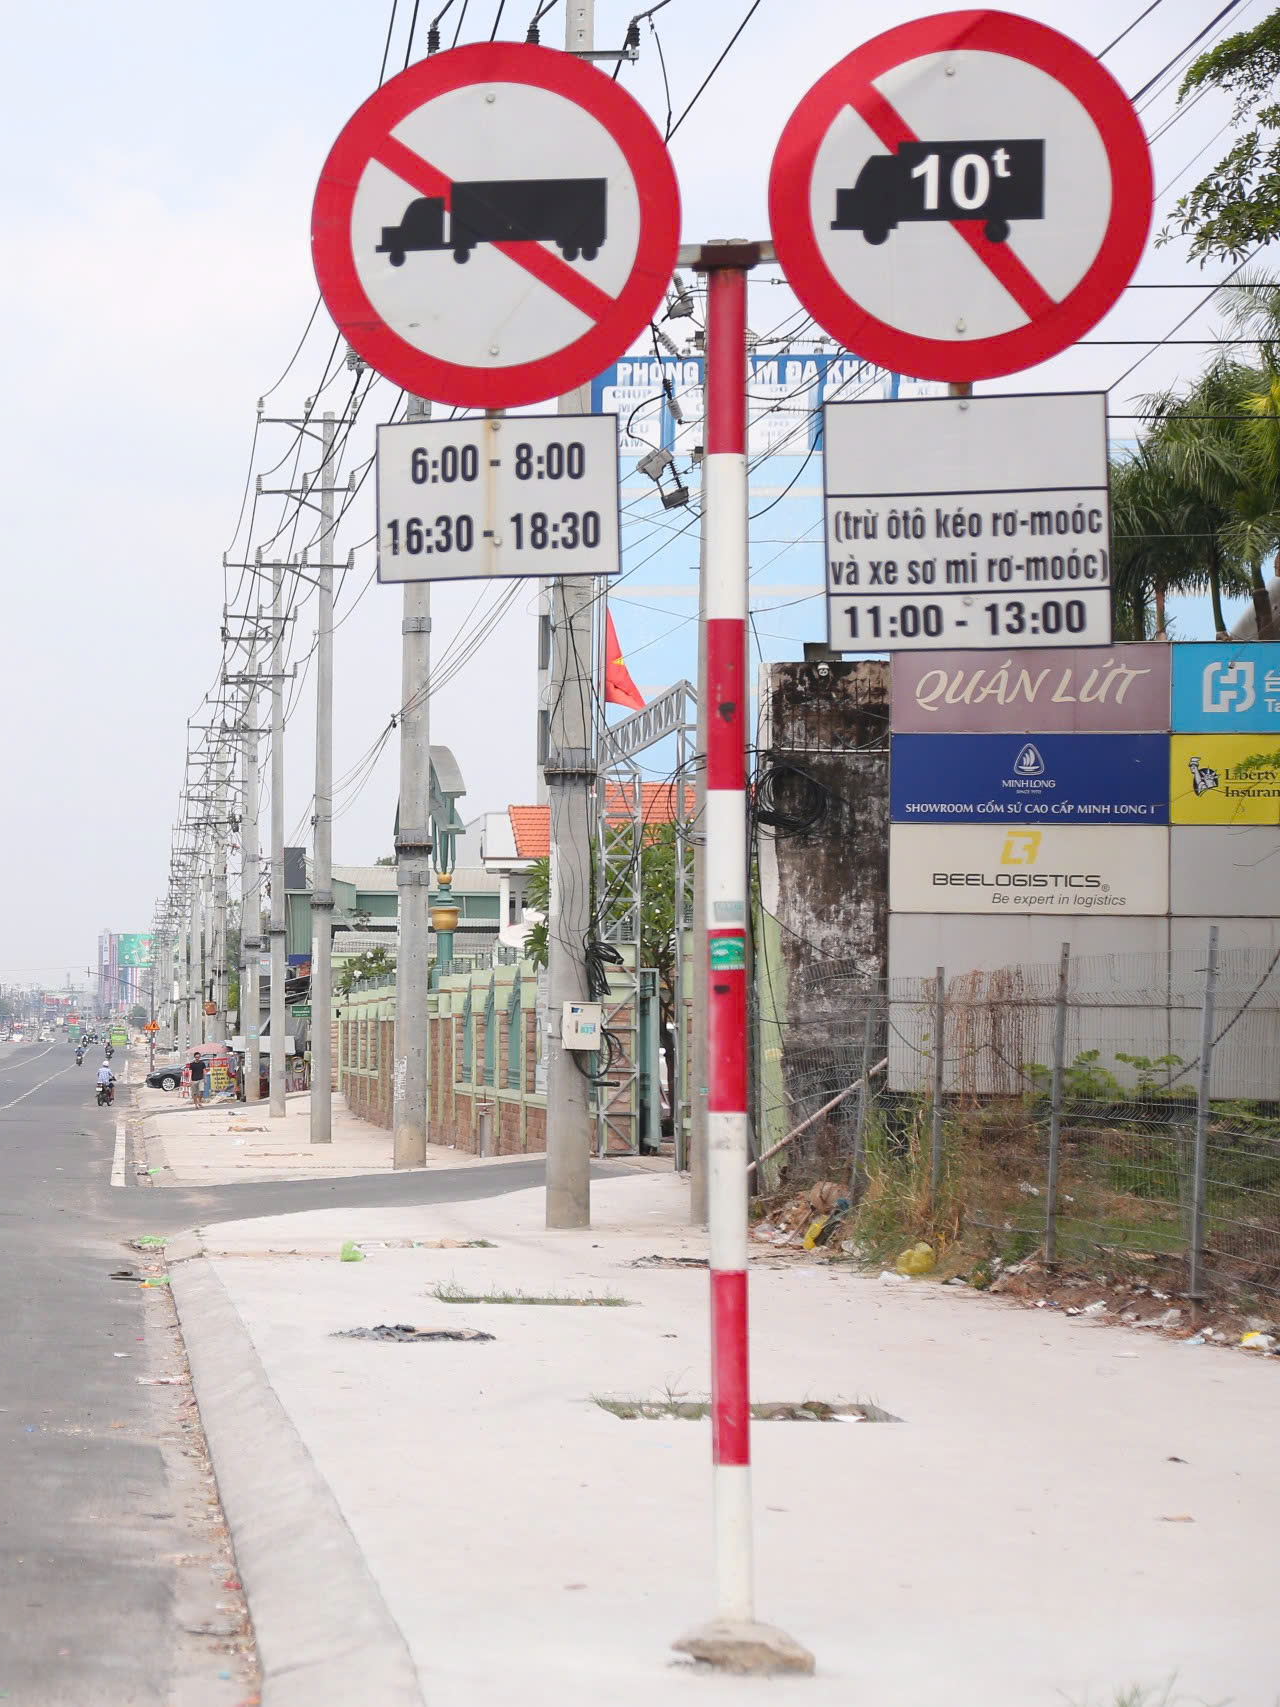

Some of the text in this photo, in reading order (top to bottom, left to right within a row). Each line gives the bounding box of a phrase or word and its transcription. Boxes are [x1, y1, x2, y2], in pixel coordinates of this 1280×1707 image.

[616, 357, 699, 386] PHÒNG
[411, 444, 479, 485] 6:00
[515, 442, 585, 480] 8:00
[387, 514, 474, 555] 16:30
[510, 510, 601, 550] 18:30
[834, 508, 879, 543] (trừ
[887, 507, 927, 540] ôtô
[935, 507, 983, 538] kéo
[831, 554, 860, 585] và
[868, 560, 898, 585] xe
[907, 557, 937, 585] sơ
[946, 552, 977, 583] mi
[844, 604, 944, 638] 11:00
[984, 600, 1087, 636] 13:00
[915, 658, 1052, 711] QUÁN
[1224, 768, 1278, 784] Liberty
[905, 803, 974, 813] SHOWROOM
[977, 800, 1004, 813] GỐM
[1024, 804, 1049, 814] CAO
[1051, 800, 1075, 814] CẤP
[1077, 804, 1111, 814] MINH
[1114, 804, 1147, 814] LONG
[992, 892, 1126, 908] Be expert in logistics
